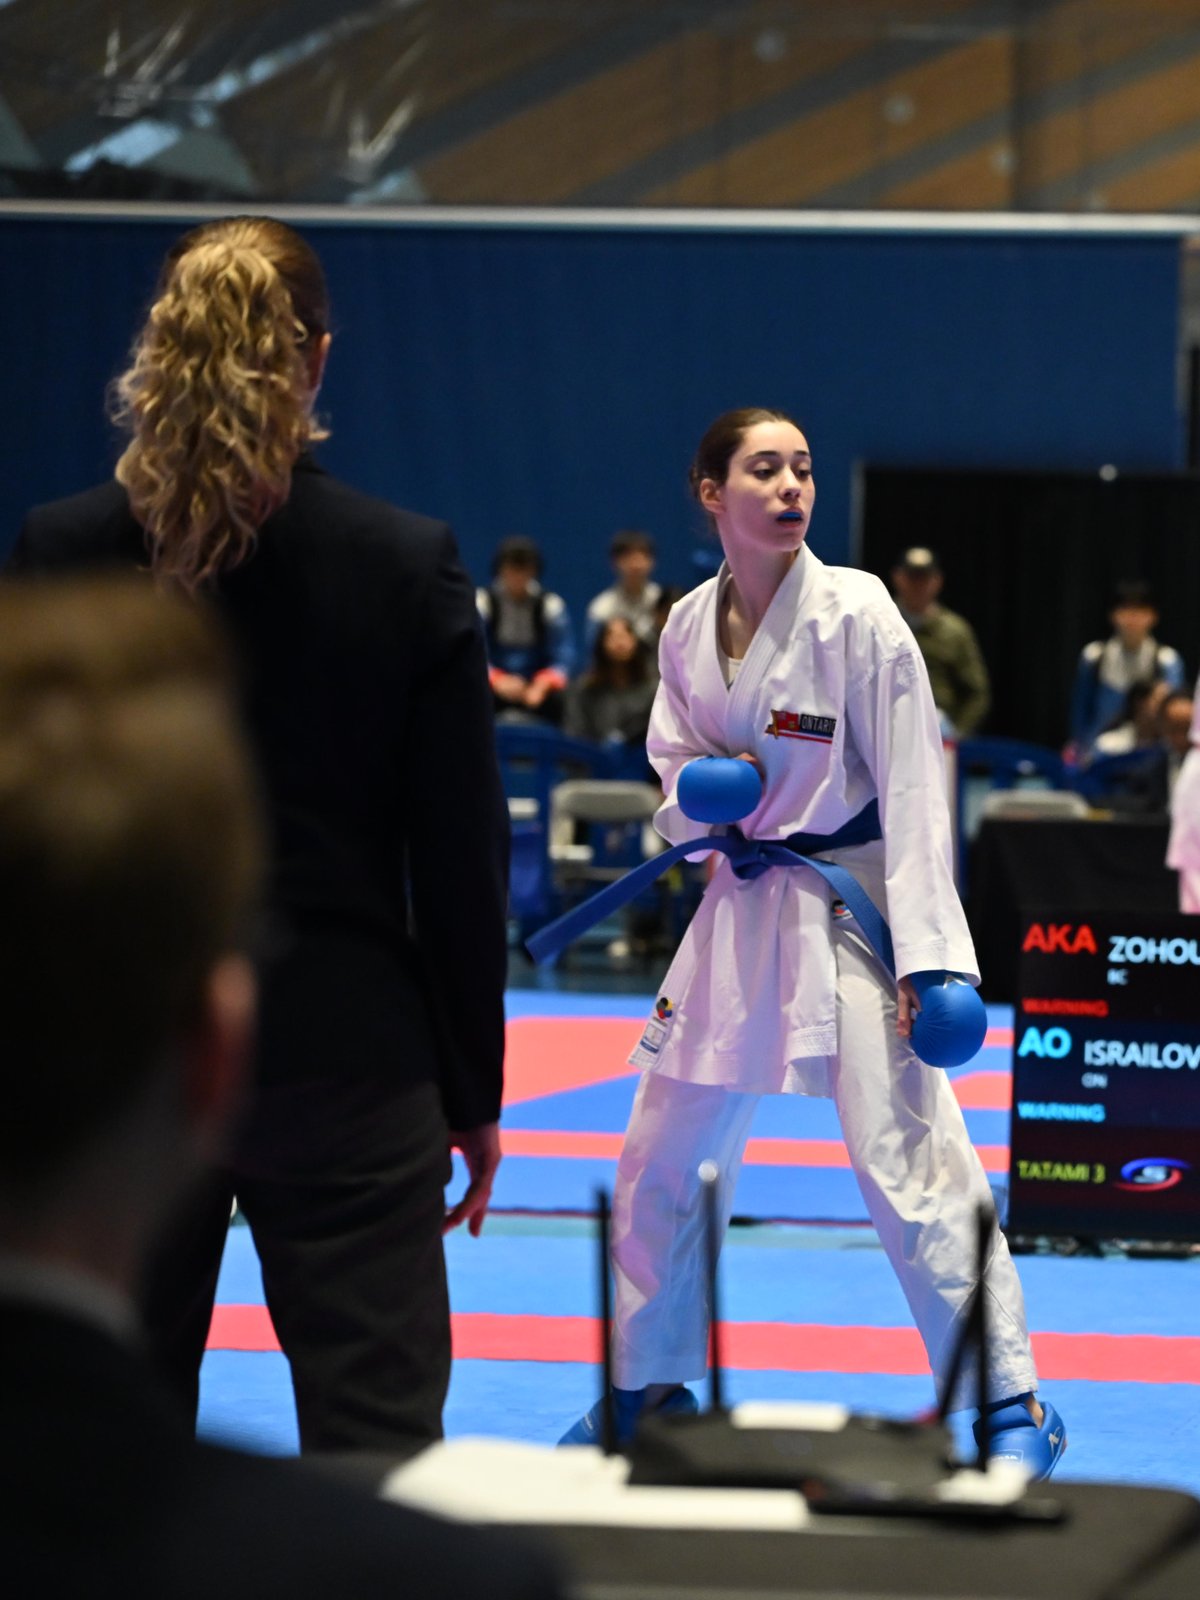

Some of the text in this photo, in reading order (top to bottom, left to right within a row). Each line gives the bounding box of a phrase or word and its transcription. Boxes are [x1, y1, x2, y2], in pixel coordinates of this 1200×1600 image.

[1022, 923, 1097, 953] AKA
[1022, 998, 1109, 1017] WARNING
[1017, 1026, 1071, 1058] AO
[1017, 1101, 1105, 1122] WARNING
[1017, 1161, 1106, 1184] TATAMI 3
